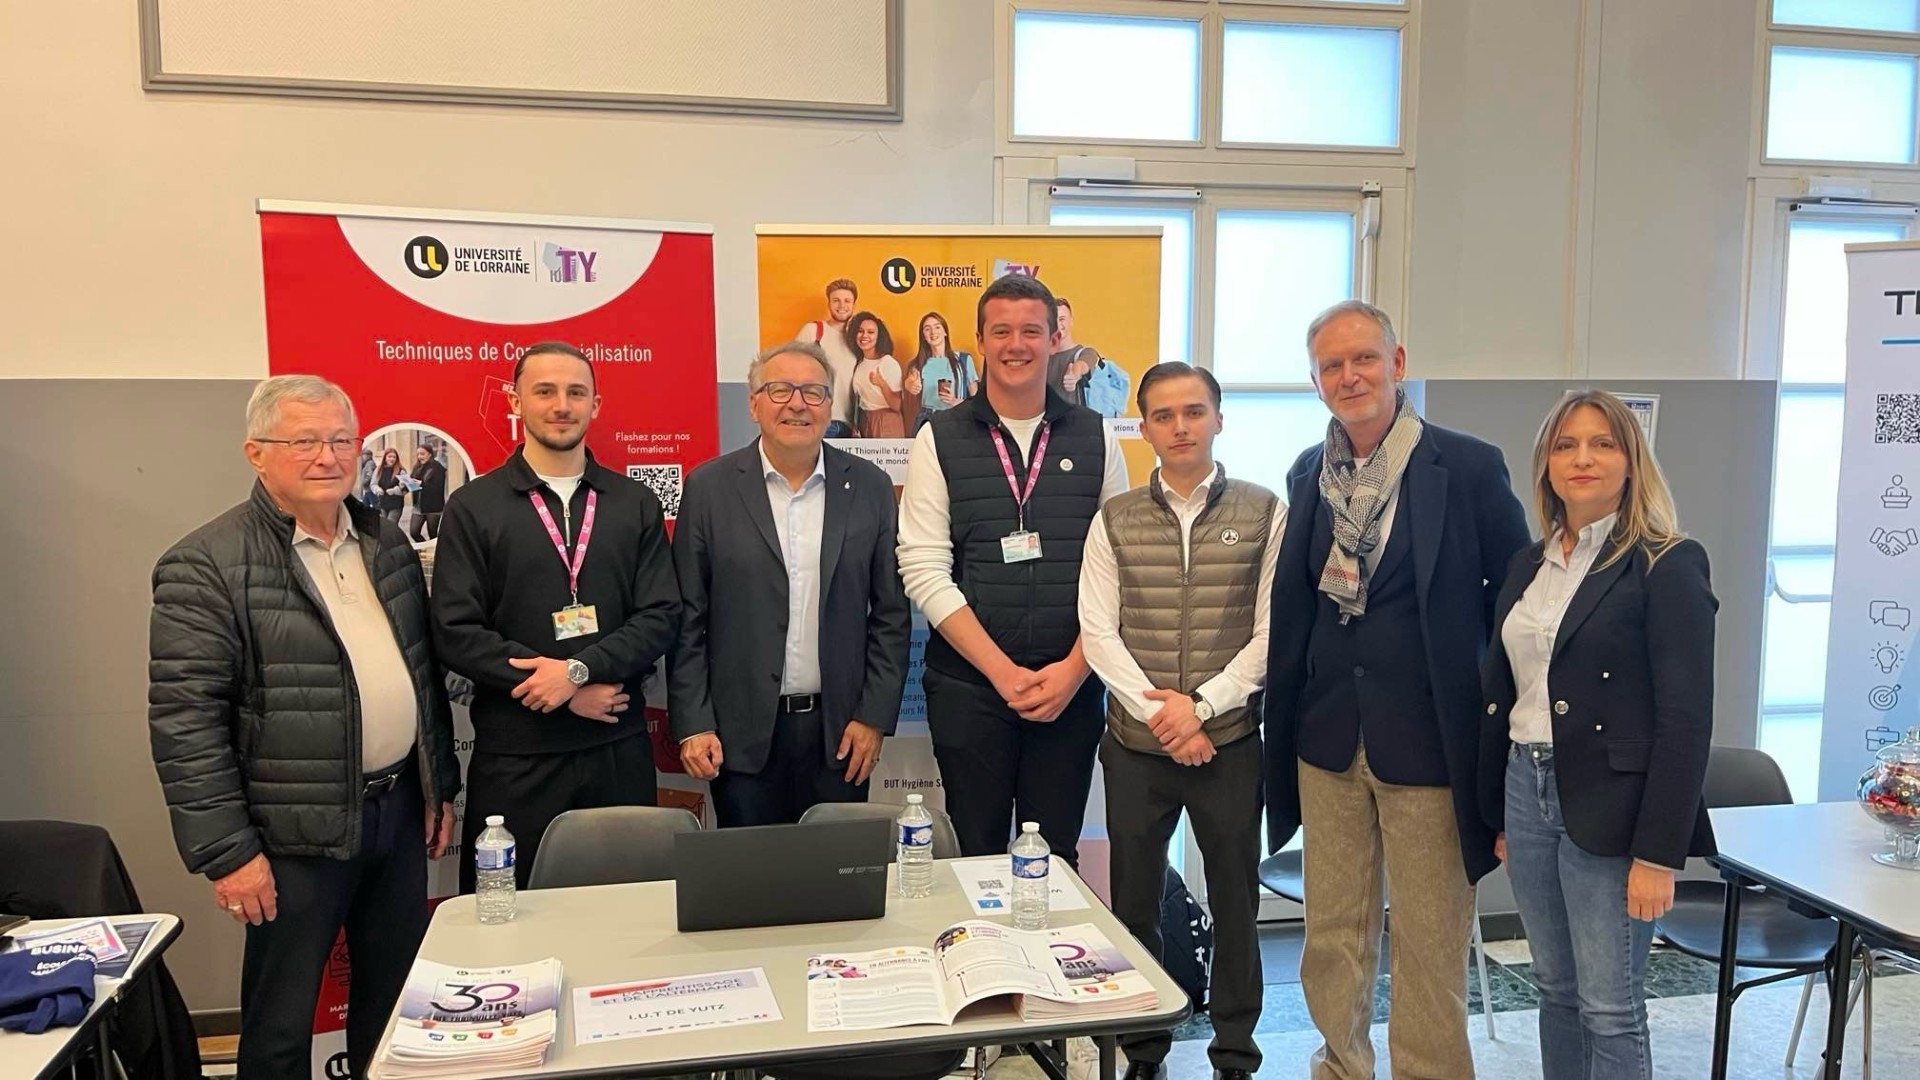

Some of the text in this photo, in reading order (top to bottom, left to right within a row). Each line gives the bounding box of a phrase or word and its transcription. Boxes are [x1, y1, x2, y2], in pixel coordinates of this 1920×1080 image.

[454, 247, 522, 261] UNIVERSITÉ
[455, 260, 530, 274] DE LORRAINE
[920, 264, 976, 277] UNIVERSITÉ
[920, 277, 982, 288] DE LORRAINE
[376, 340, 473, 363] Techniques
[479, 342, 498, 360] de
[615, 431, 690, 443] Flashez pour nos
[627, 444, 674, 454] formations
[884, 779, 899, 788] BUT
[901, 778, 934, 790] Hygiène
[481, 1000, 518, 1011] ans
[666, 1008, 685, 1016] DE
[689, 1003, 725, 1013] YUTZ
